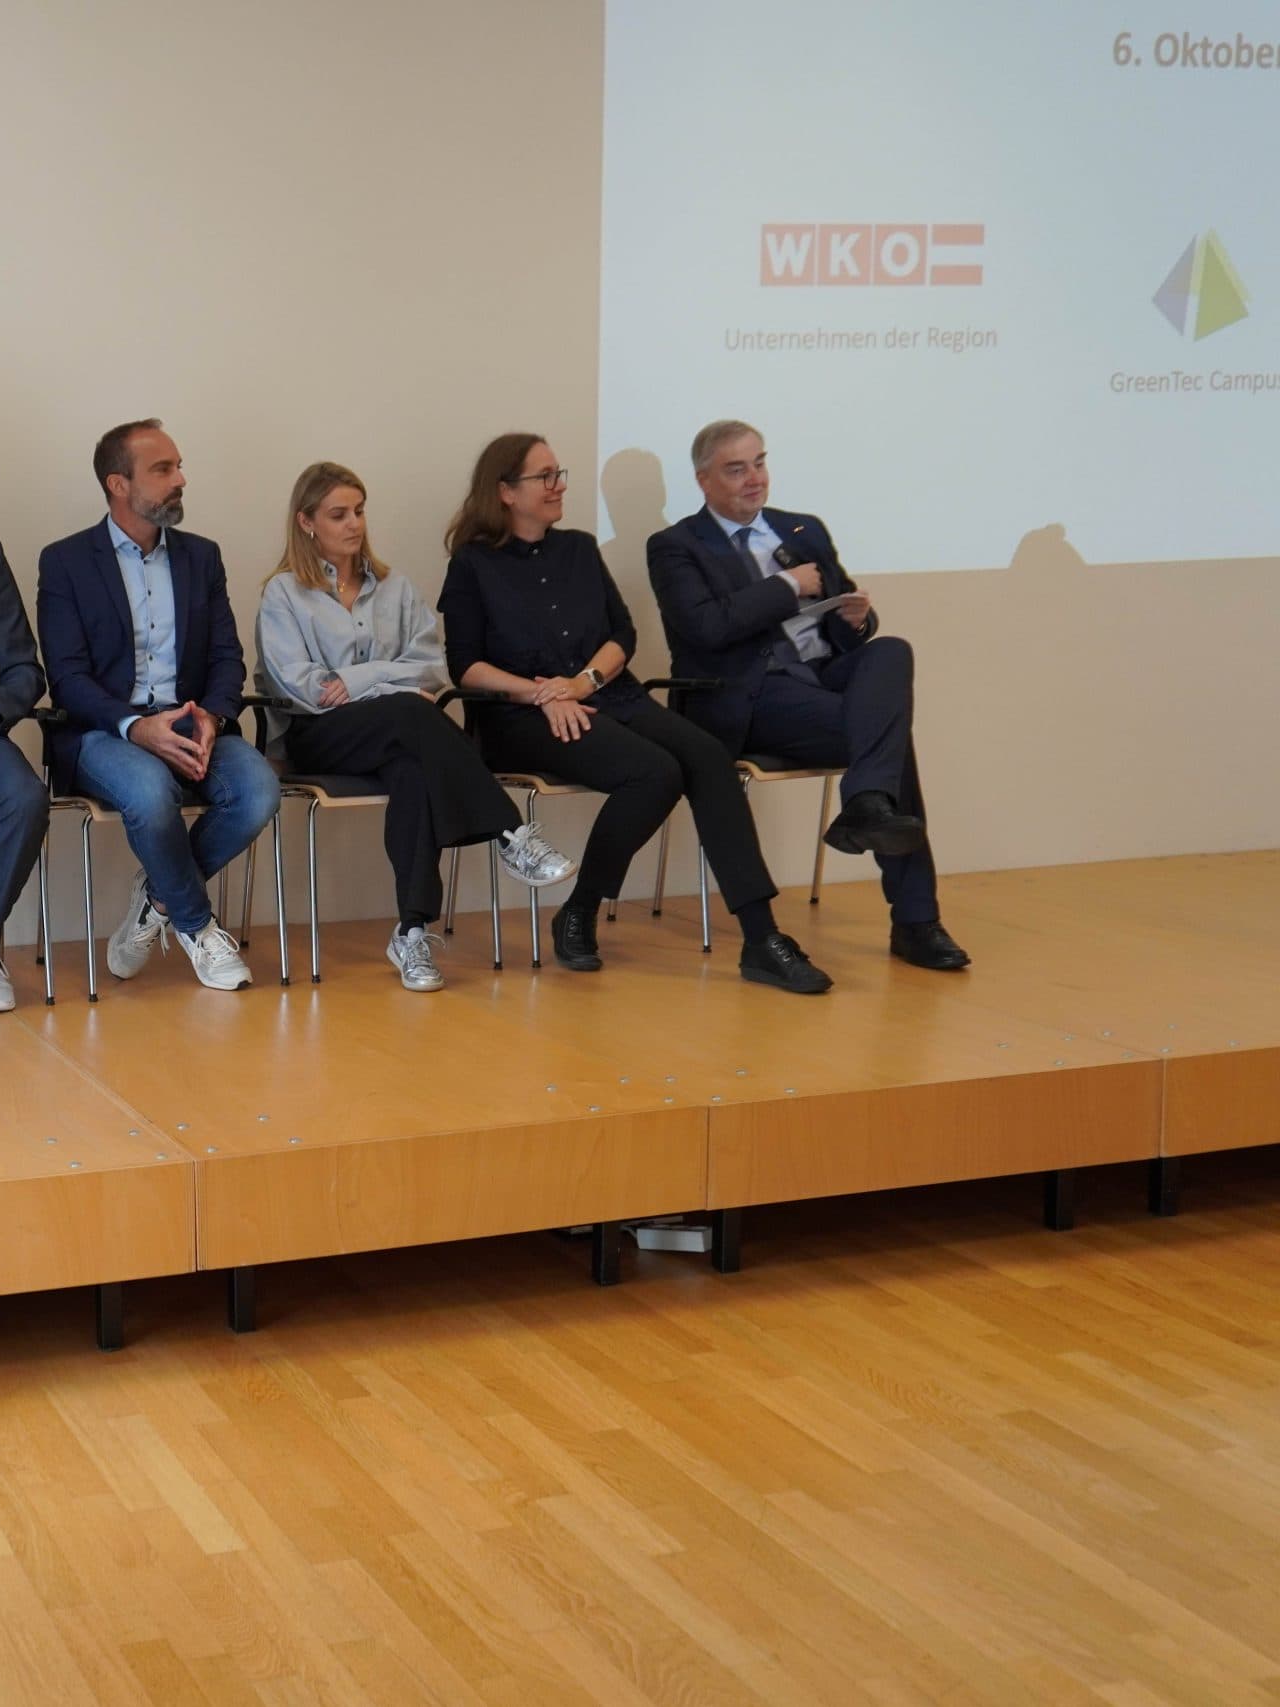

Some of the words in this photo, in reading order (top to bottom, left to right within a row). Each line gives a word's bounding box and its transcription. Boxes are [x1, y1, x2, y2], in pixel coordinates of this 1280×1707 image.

[1113, 32, 1142, 67] 6.
[1154, 32, 1280, 69] Oktobe
[765, 232, 920, 277] WKO
[725, 328, 877, 350] Unternehmen
[884, 327, 919, 349] der
[928, 326, 998, 353] Region
[1110, 371, 1203, 393] GreenTec
